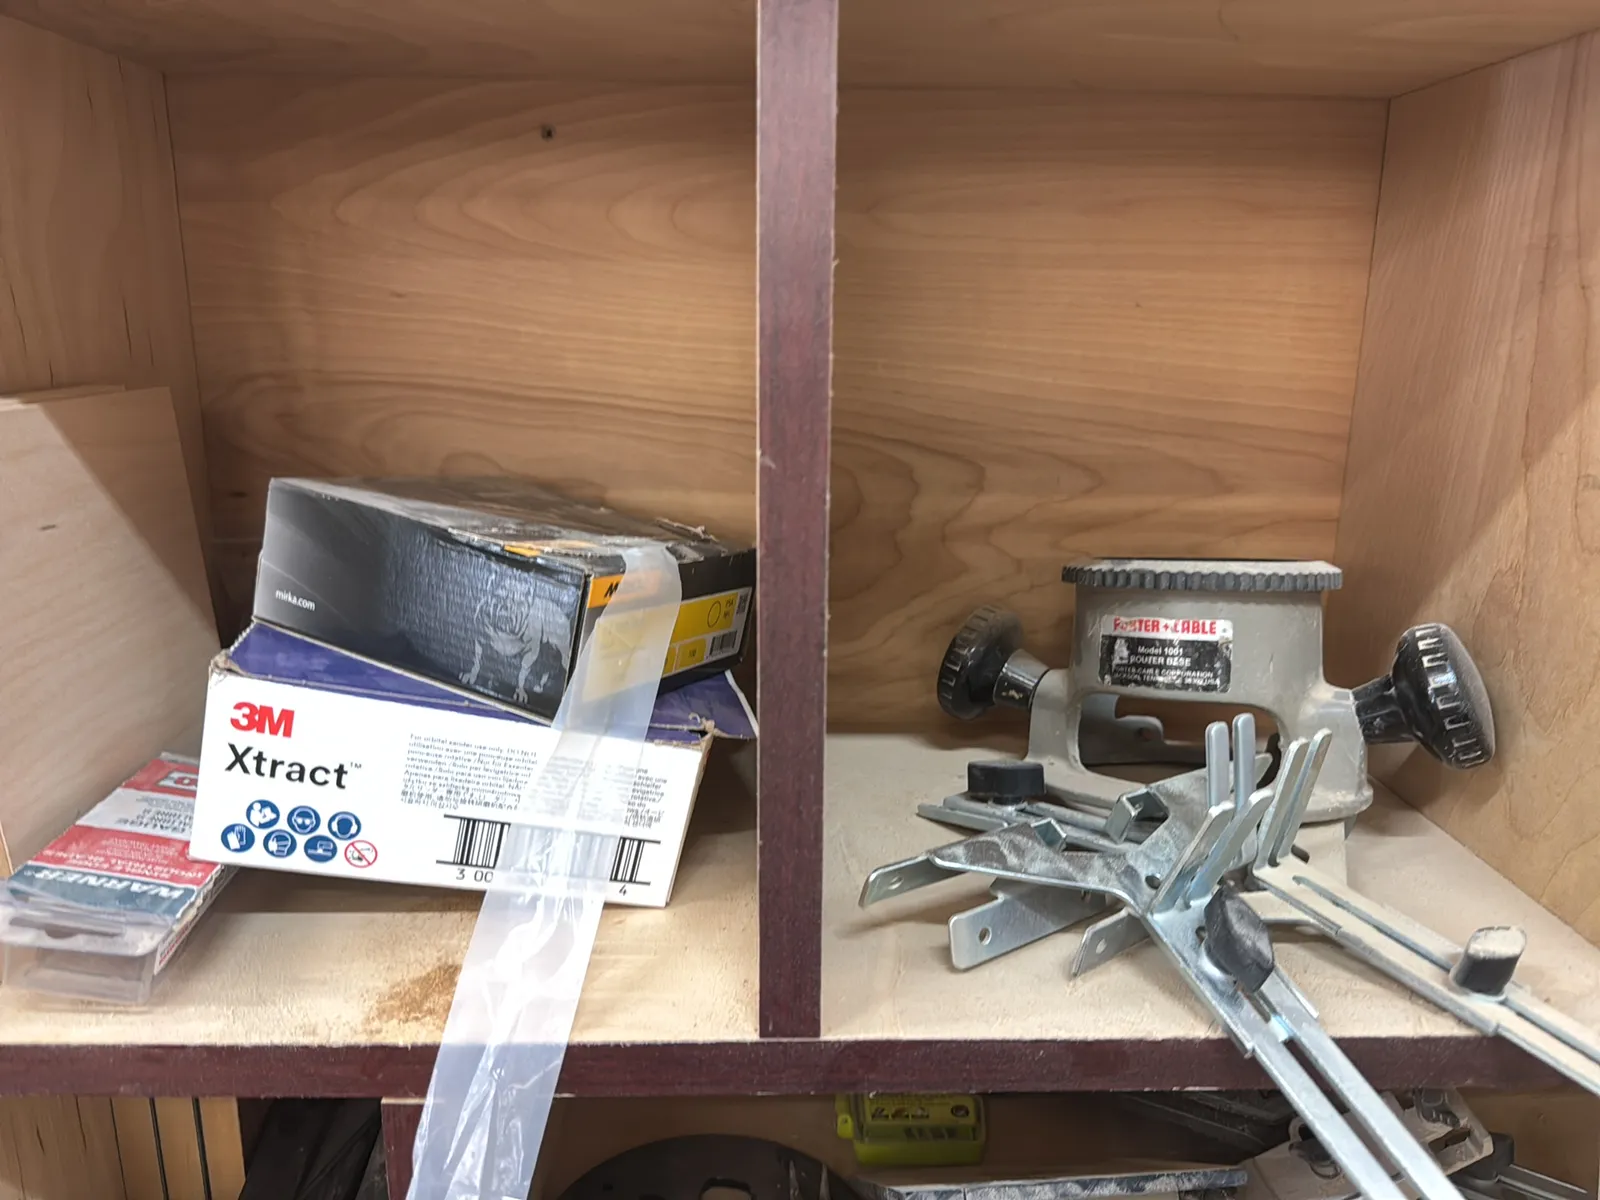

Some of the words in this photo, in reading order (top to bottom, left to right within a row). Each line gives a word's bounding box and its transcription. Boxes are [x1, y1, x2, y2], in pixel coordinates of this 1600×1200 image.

[275, 589, 316, 611] mirka.com
[1130, 655, 1165, 665] ROUTER
[1138, 645, 1162, 655] Model
[229, 701, 295, 739] 3M
[456, 868, 466, 880] 3
[619, 885, 627, 896] 4
